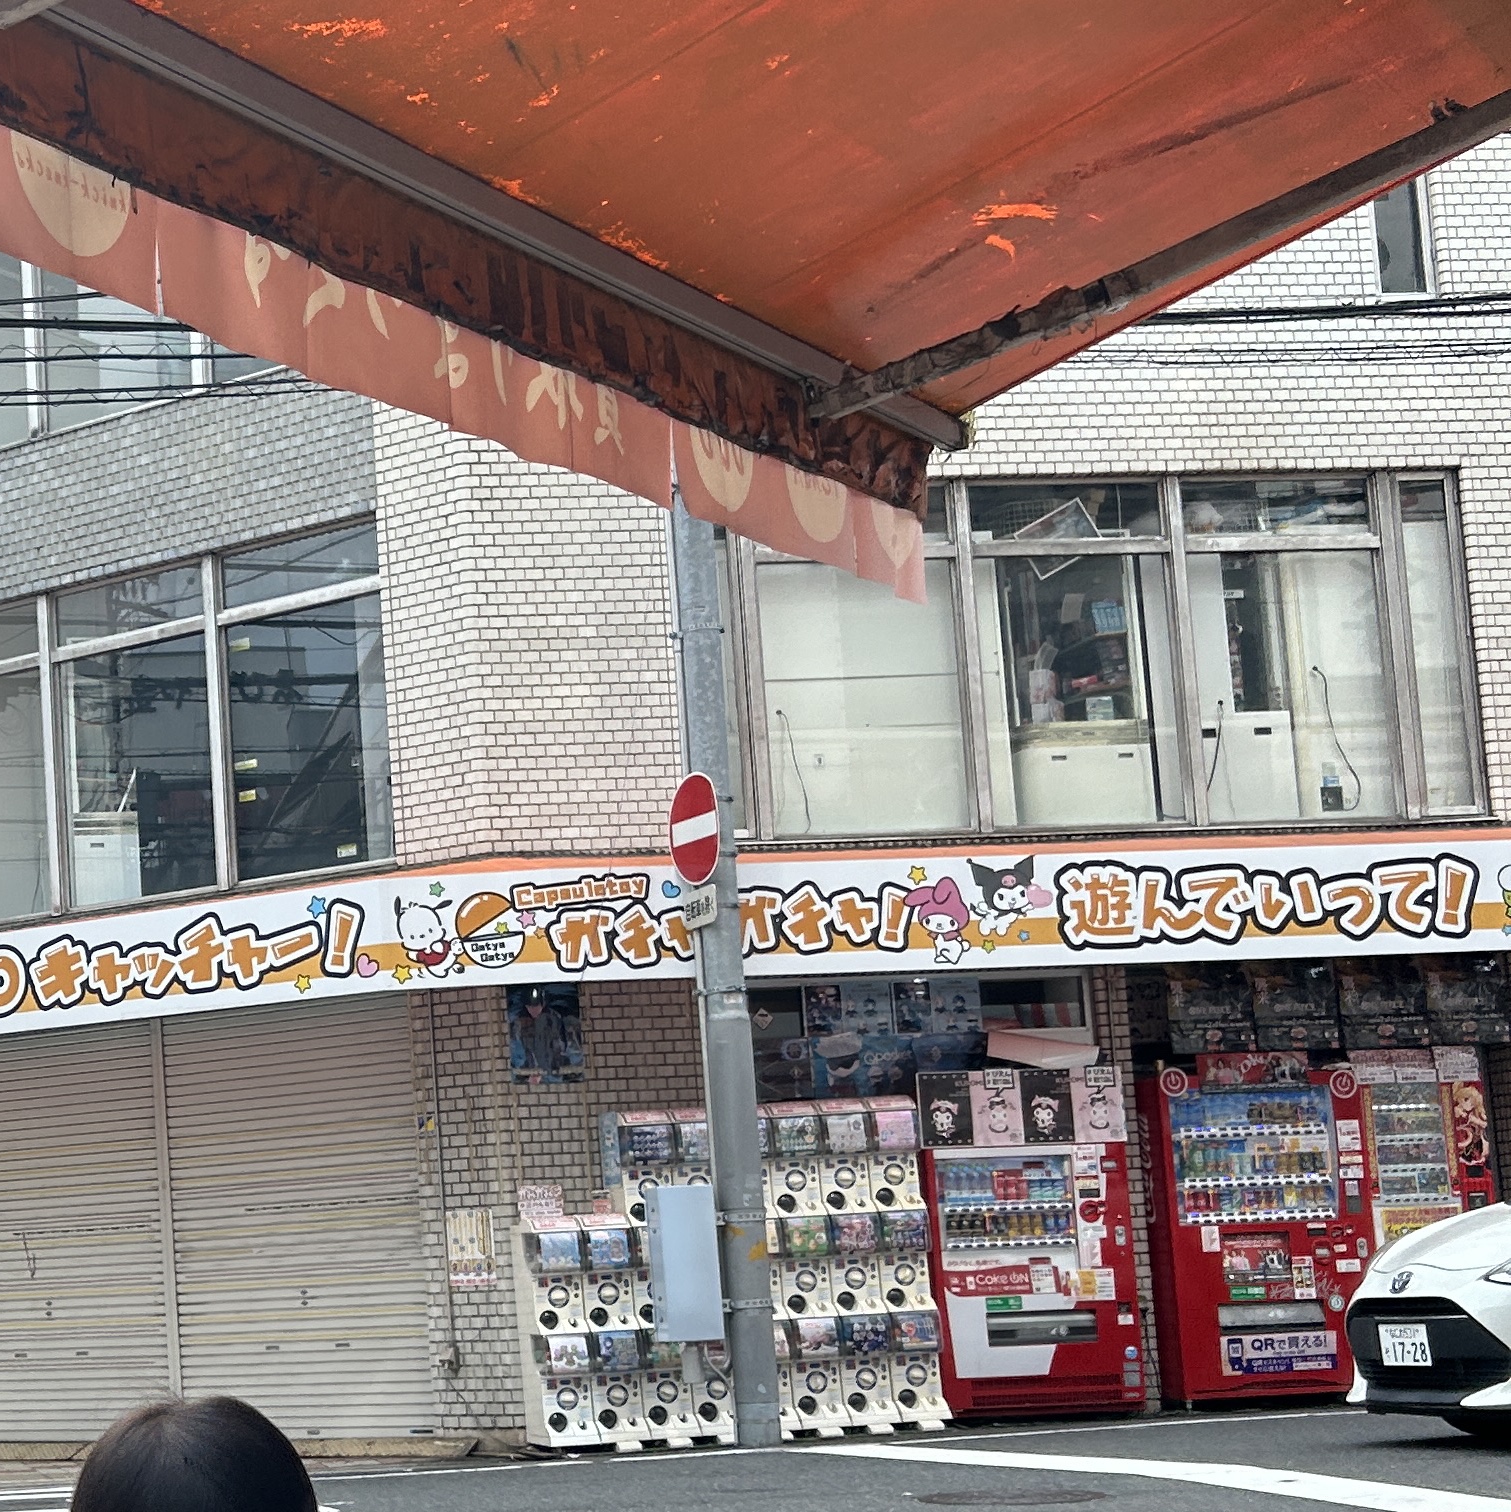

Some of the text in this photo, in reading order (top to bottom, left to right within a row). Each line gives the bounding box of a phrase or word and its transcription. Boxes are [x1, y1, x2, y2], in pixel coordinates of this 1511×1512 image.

[1065, 861, 1474, 941] 遊んでいって!
[975, 1273, 1009, 1286] Coke
